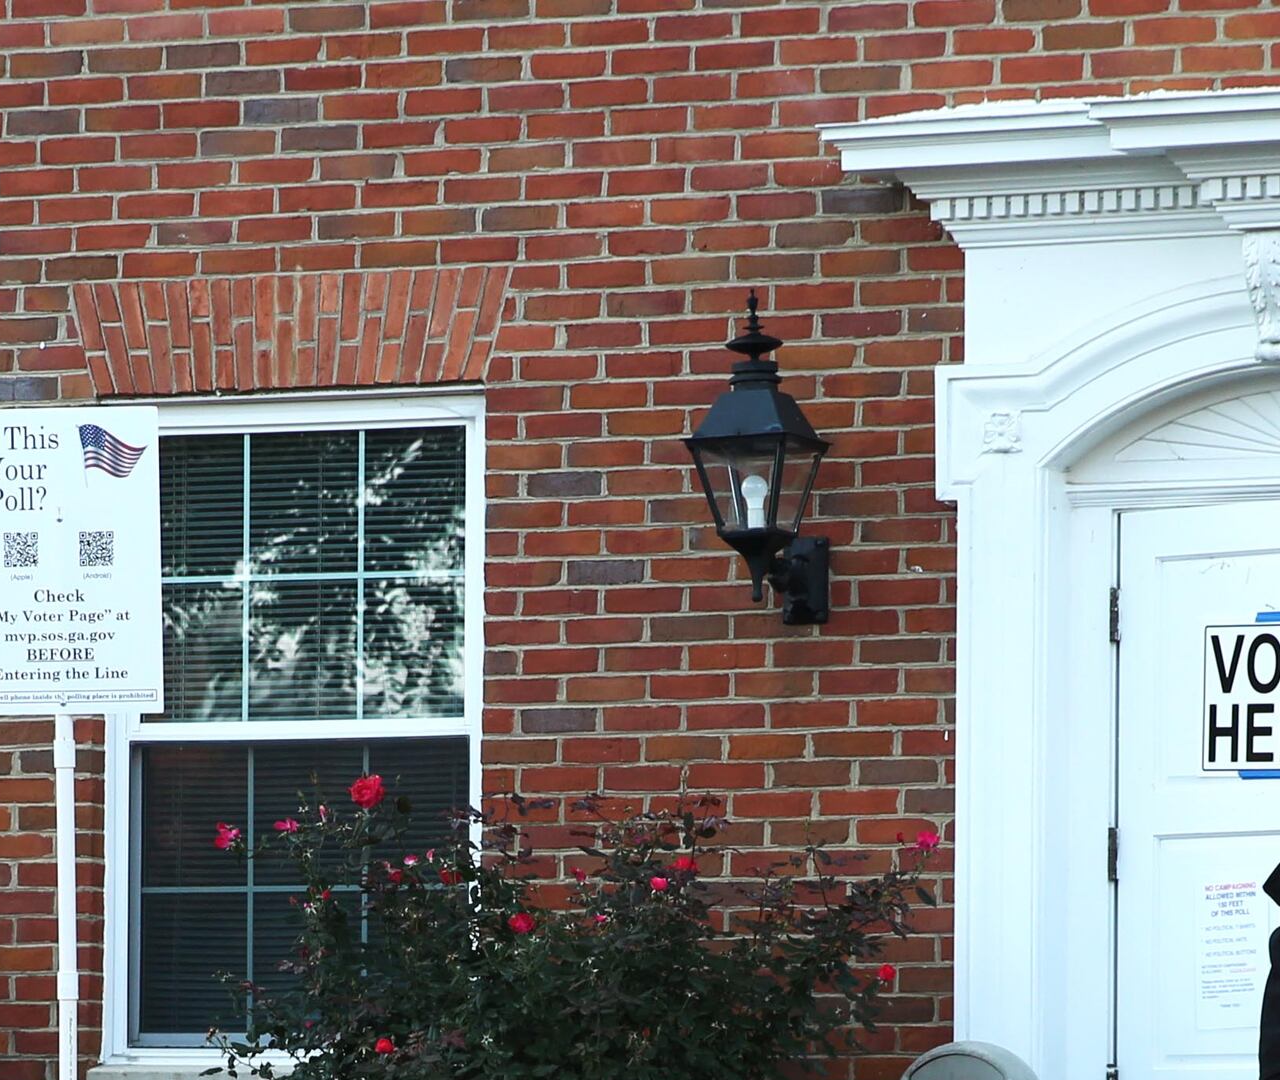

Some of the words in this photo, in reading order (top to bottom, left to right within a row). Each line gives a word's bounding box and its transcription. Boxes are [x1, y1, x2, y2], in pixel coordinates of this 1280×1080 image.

[4, 426, 59, 450] This
[83, 572, 112, 580] (Android)
[34, 589, 85, 603] Check
[23, 610, 64, 622] Voter
[116, 611, 131, 621] at
[5, 632, 116, 644] mvp.sos.ga.gov
[27, 648, 95, 661] BEFORE
[66, 667, 89, 680] the
[95, 667, 128, 679] Line
[67, 693, 90, 701] polling
[119, 692, 154, 700] prohibited
